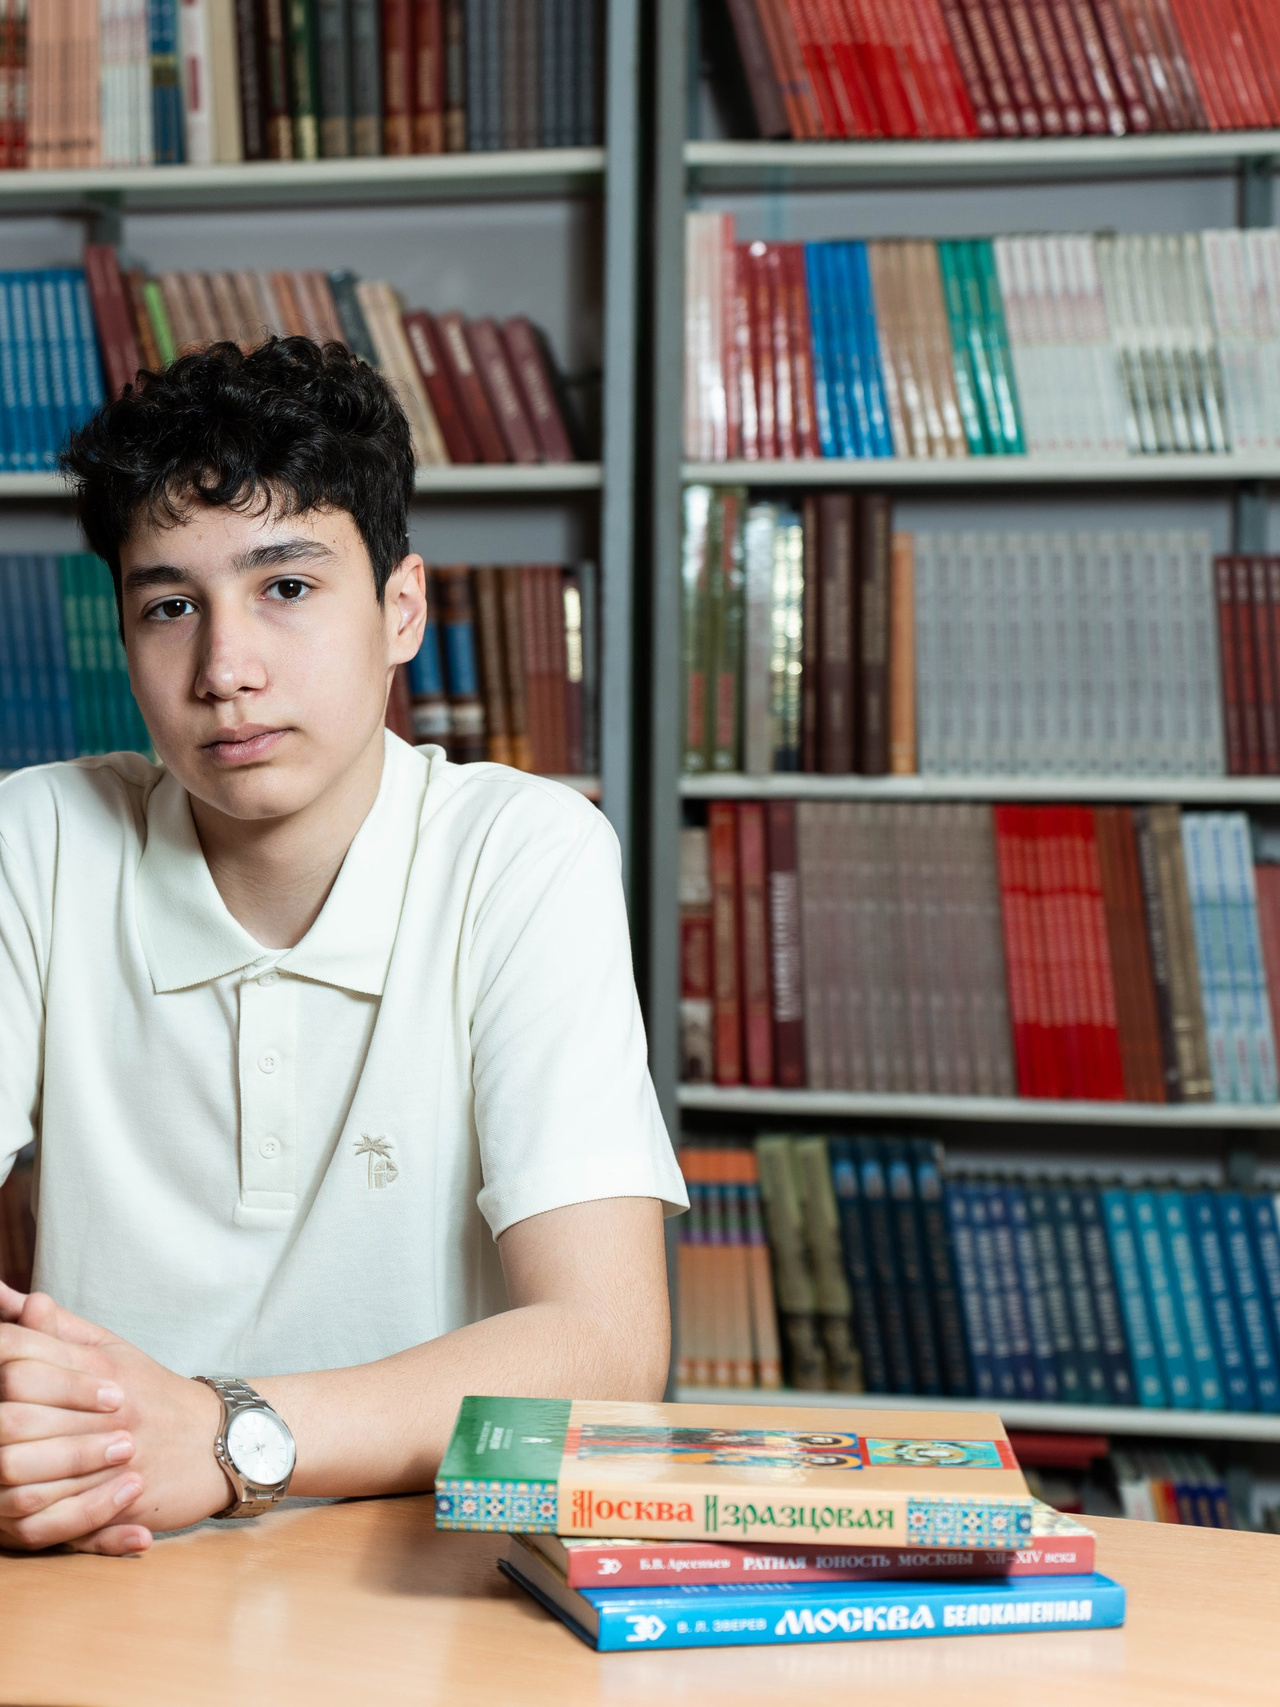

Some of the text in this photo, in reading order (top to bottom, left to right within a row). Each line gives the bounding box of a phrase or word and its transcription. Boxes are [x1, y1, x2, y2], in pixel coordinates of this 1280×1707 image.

[572, 1489, 895, 1534] Москва Изразцовая
[742, 1556, 807, 1571] РАТНАЯ
[816, 1554, 891, 1569] ЮНОСТЬ
[897, 1551, 974, 1567] МОСКВЫ
[1044, 1551, 1077, 1564] века
[774, 1604, 936, 1636] МОСКВА
[943, 1599, 1093, 1628] БЕЛОКАМЕННАЯ
